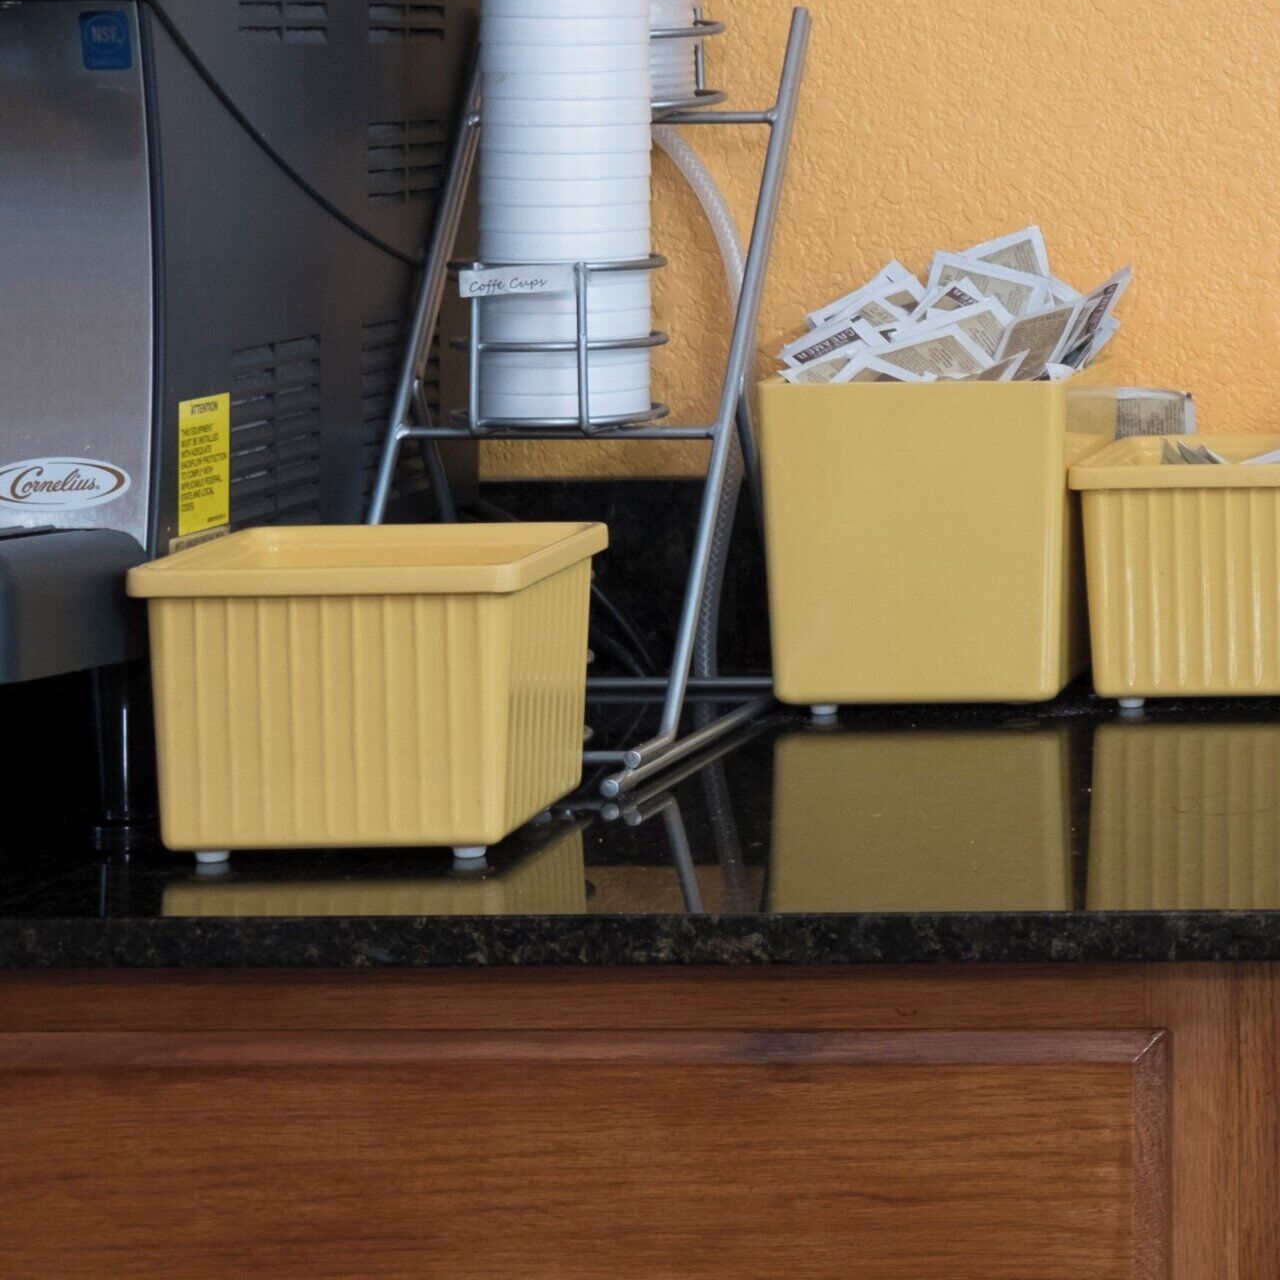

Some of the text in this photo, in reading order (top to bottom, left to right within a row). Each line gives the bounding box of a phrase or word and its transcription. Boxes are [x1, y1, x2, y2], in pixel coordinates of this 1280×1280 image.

[91, 26, 119, 43] NSF
[509, 277, 548, 289] Cups
[797, 327, 855, 360] CREAMER
[190, 401, 218, 416] ATTENTION
[10, 466, 97, 500] Cornelius
